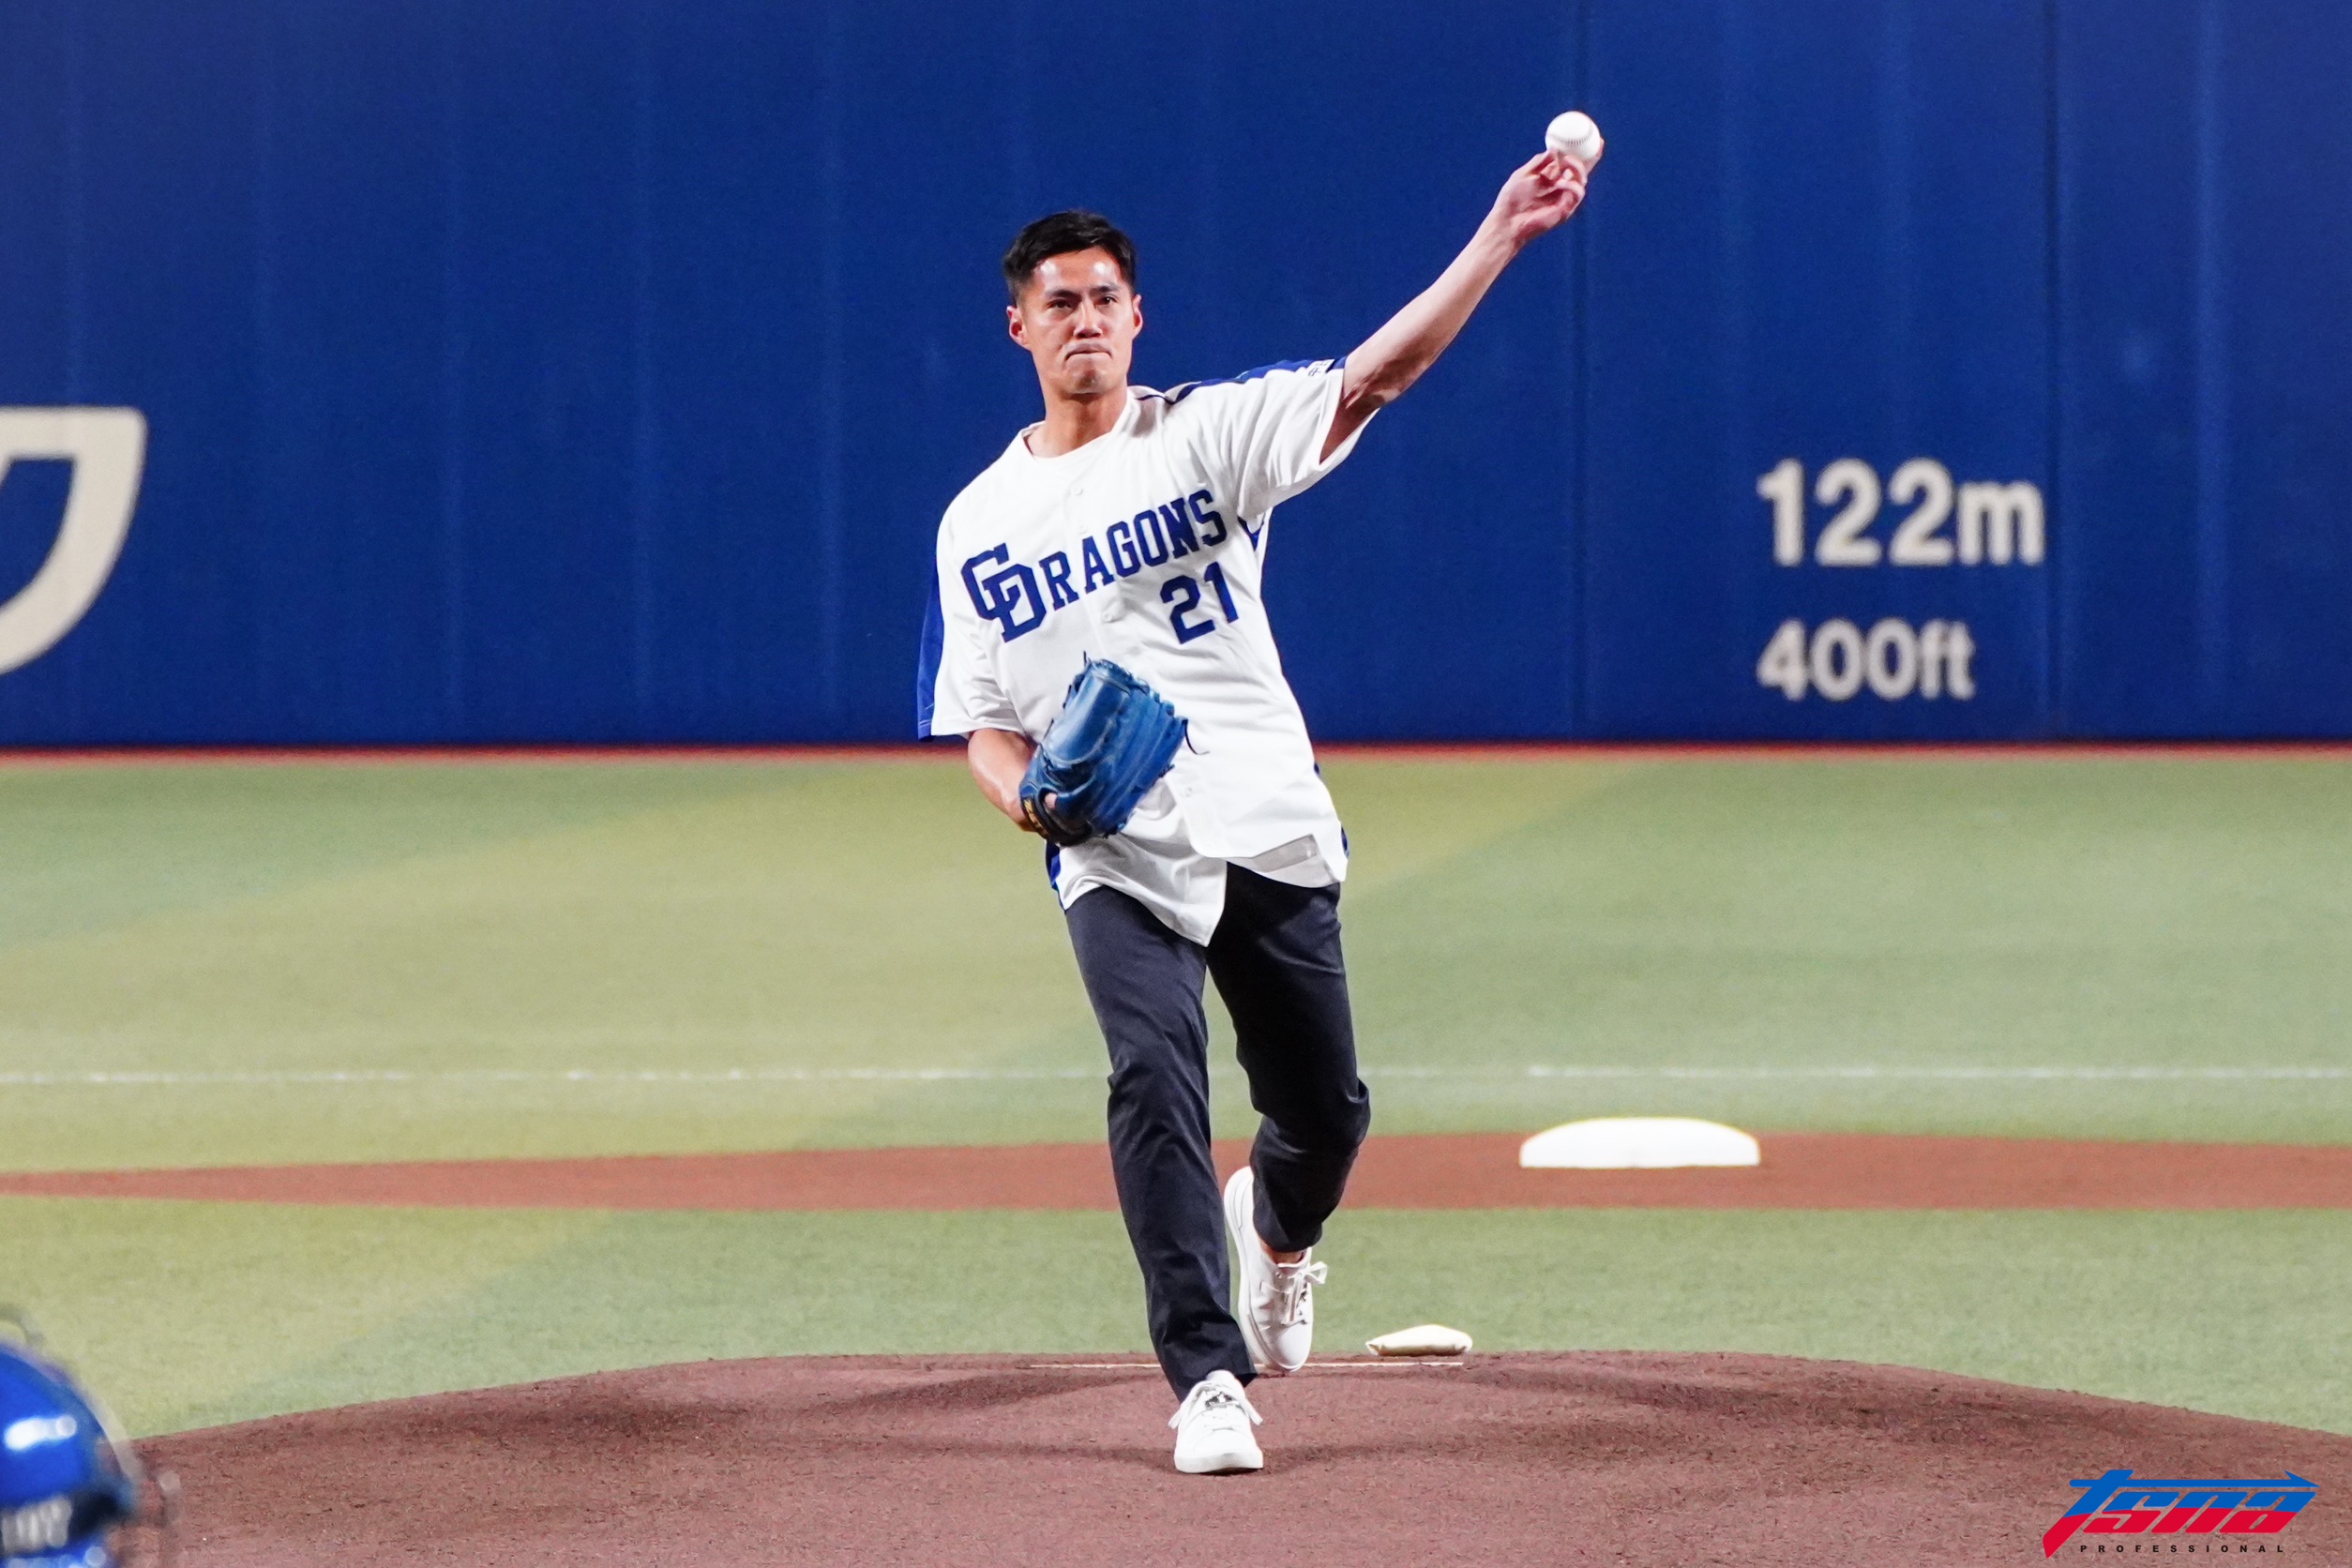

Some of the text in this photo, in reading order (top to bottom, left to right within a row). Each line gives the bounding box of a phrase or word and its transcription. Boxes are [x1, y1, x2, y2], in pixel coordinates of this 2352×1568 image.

[1756, 458, 2045, 566] 122m
[1160, 562, 1239, 644] 21
[1756, 619, 1976, 700] 400ft
